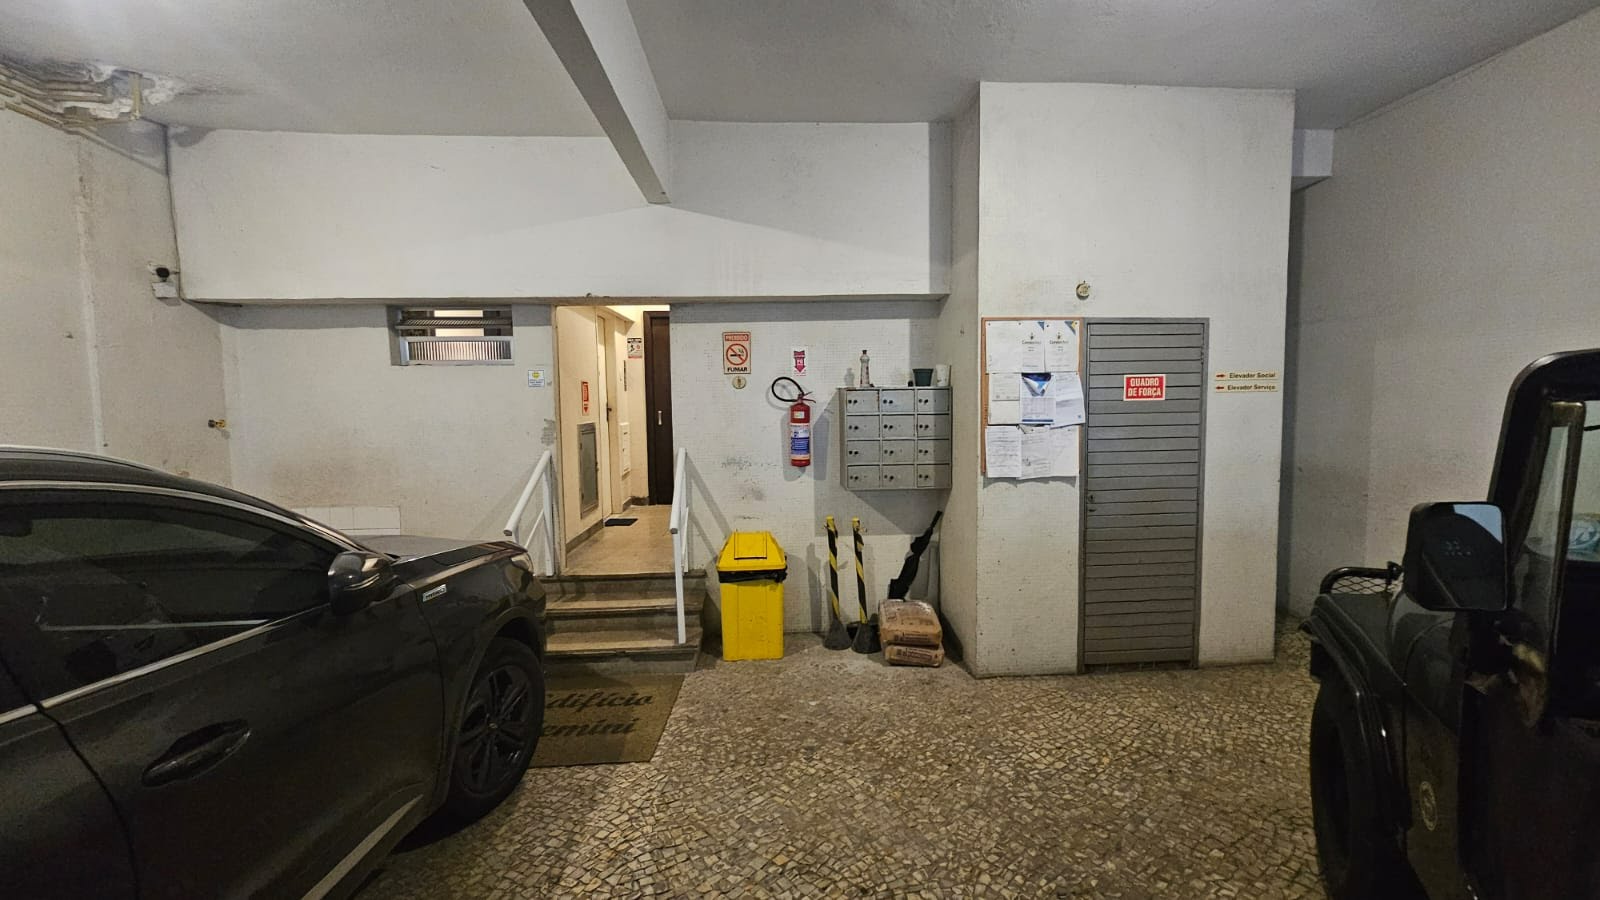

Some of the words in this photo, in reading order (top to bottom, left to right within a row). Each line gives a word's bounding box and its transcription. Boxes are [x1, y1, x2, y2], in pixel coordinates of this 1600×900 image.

[1130, 377, 1159, 387] QUADRO
[1127, 387, 1138, 397] DE
[1138, 387, 1162, 398] FORÇA
[543, 718, 639, 737] emini
